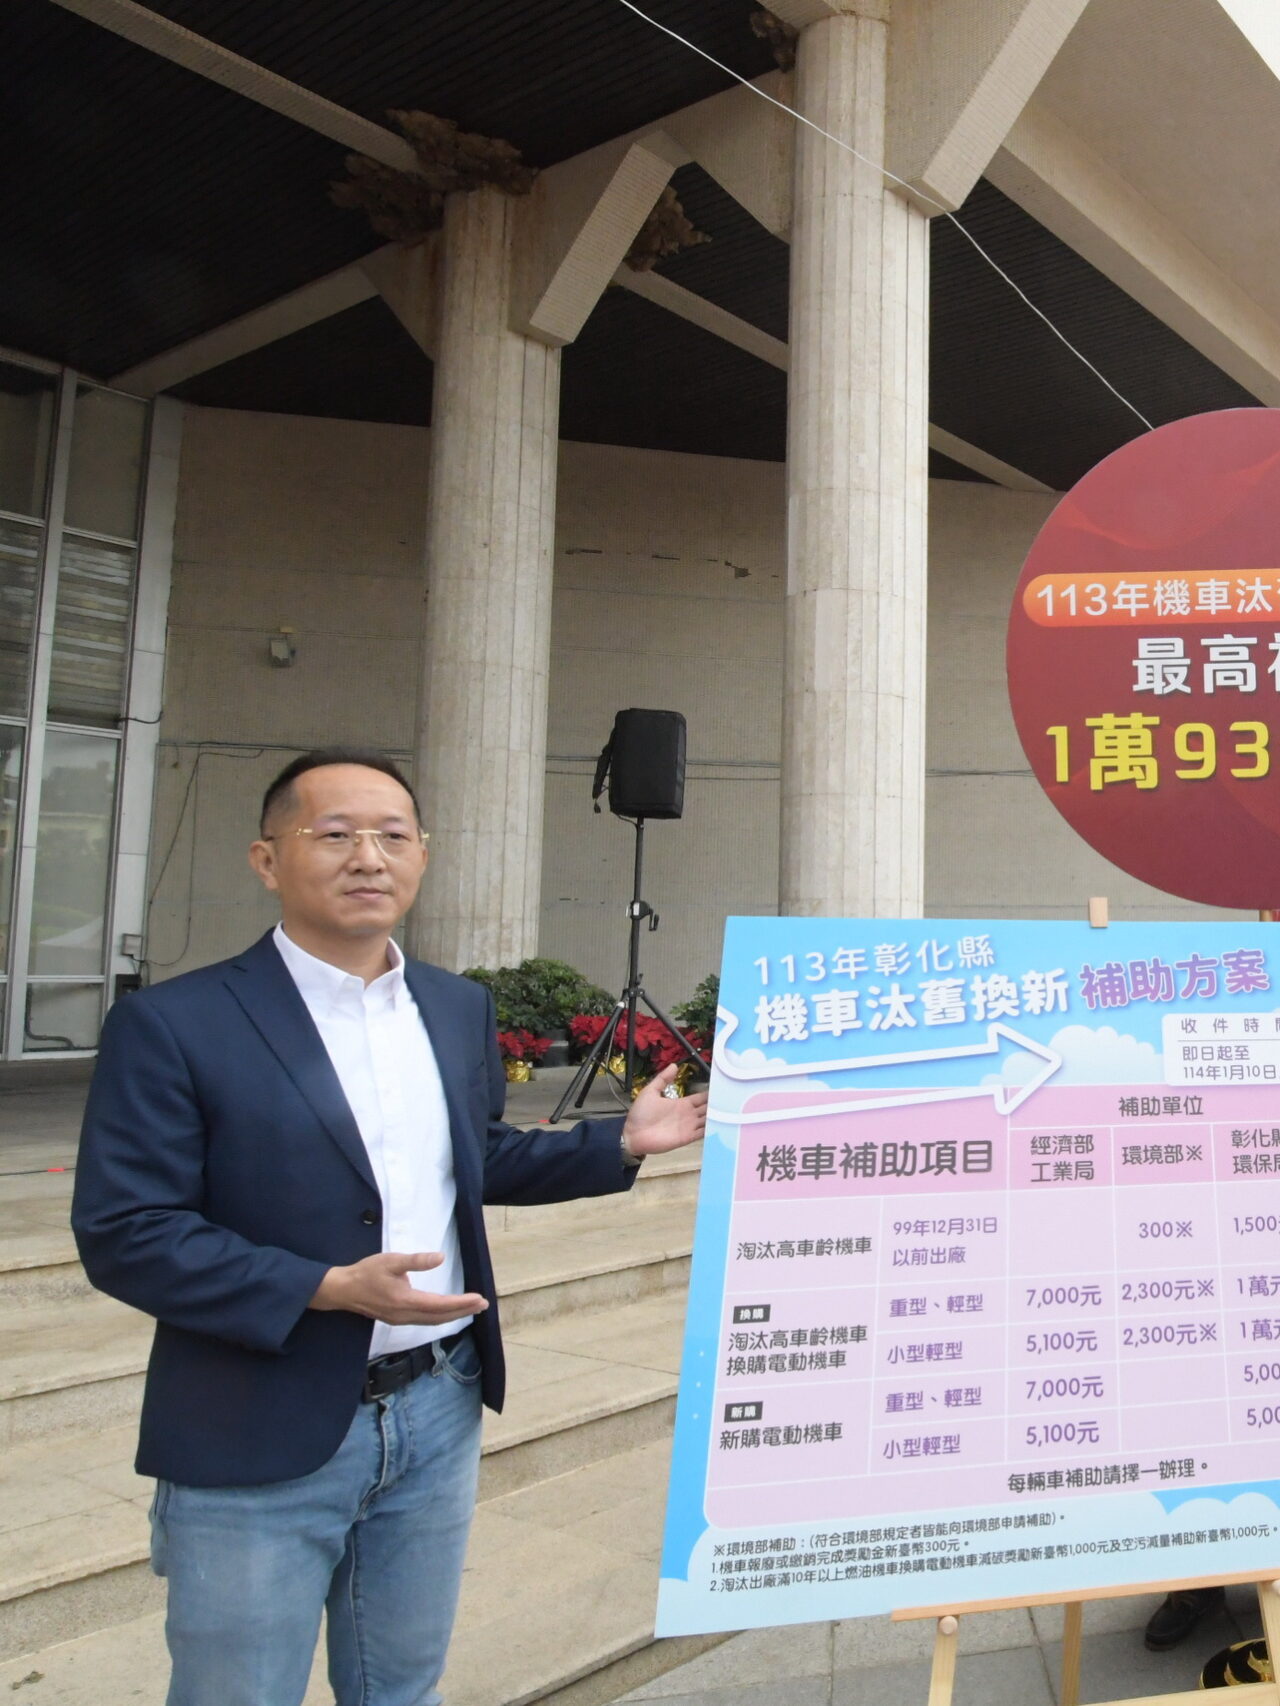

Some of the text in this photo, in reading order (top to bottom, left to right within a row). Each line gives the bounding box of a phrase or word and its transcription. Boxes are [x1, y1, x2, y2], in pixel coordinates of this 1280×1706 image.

[753, 934, 995, 985] 113年彰化縣
[754, 948, 1270, 1044] 機車汰舊換新 補助方案
[1182, 1045, 1251, 1062] 即日起至
[1118, 1095, 1204, 1117] 補助單位
[1030, 1134, 1094, 1156] 經濟部
[755, 1140, 993, 1183] 機車補助項目
[1030, 1160, 1095, 1183] 工業局
[893, 1217, 998, 1237] 99年12月31日
[736, 1235, 873, 1262] 淘汰高車齡機車
[892, 1246, 967, 1267] 以前出廠
[1026, 1285, 1102, 1309] 7,000元
[728, 1325, 868, 1351] 淘汰高車齡機車
[1026, 1330, 1098, 1355] 5,100元
[726, 1349, 847, 1376] 換購電動機車
[887, 1341, 963, 1364] 小型輕型
[1026, 1376, 1104, 1401] 7,000元
[719, 1421, 843, 1450] 新購電動機車
[883, 1434, 961, 1459] 小型輕型
[1026, 1421, 1100, 1447] 5,100元
[1008, 1458, 1208, 1493] 每輛車補助請擇一辦理。
